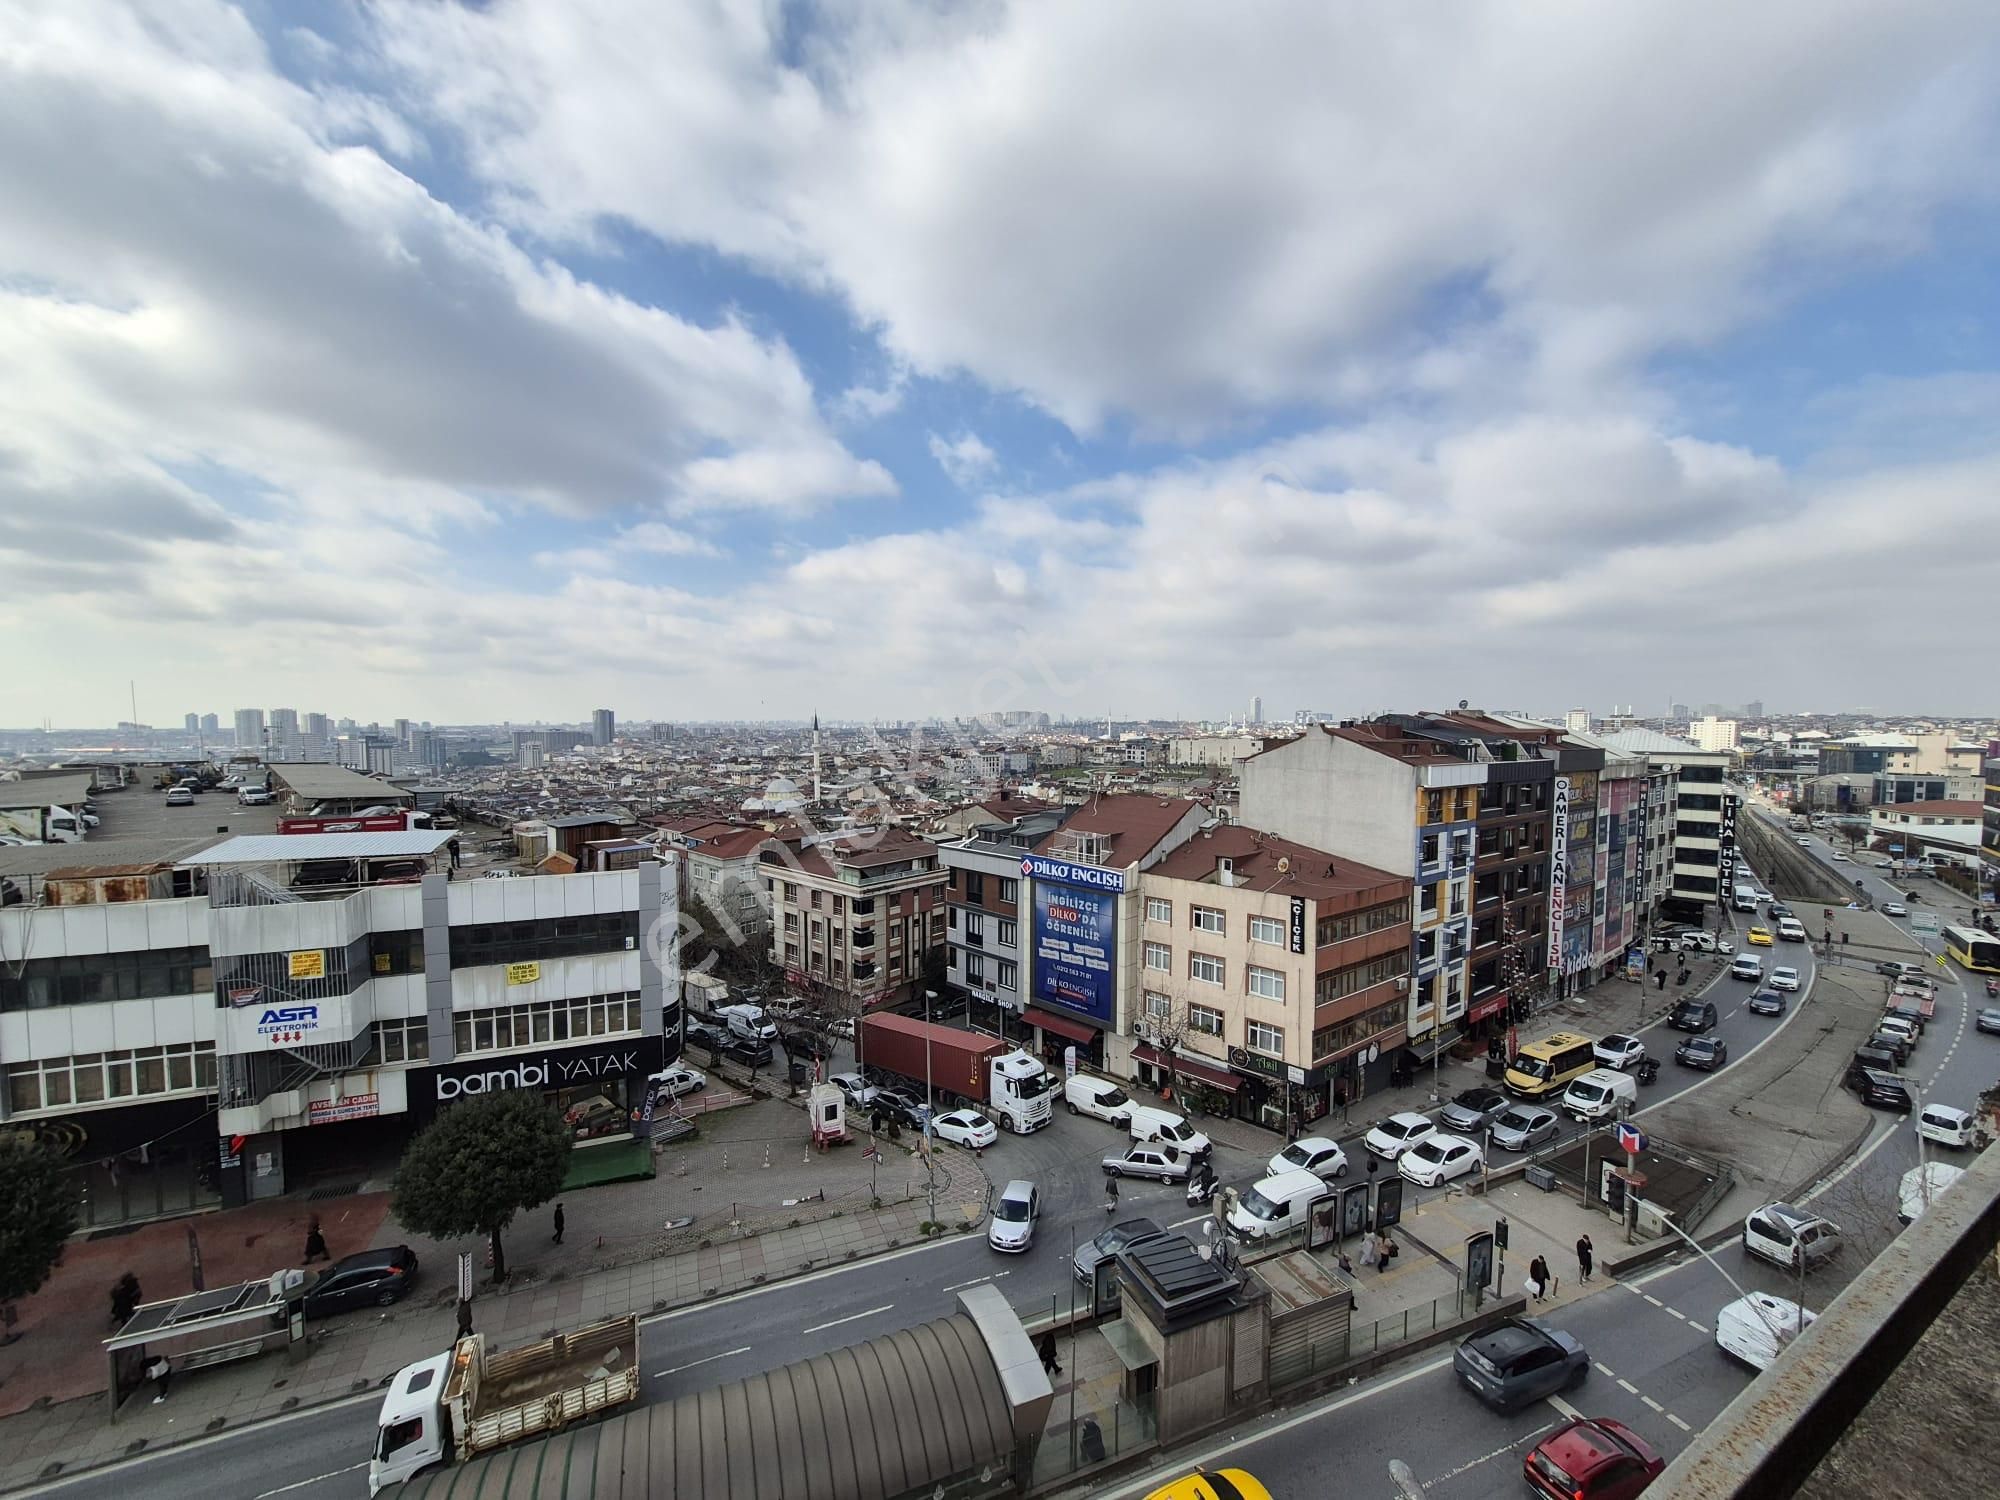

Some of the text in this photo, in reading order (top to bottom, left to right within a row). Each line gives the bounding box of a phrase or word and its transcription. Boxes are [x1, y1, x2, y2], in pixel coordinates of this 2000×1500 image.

[1552, 791, 1567, 885] AMERICAN
[1071, 867, 1123, 889] ENGLISH
[1721, 848, 1733, 896] HOTEL
[1047, 892, 1099, 912] İNGİLİZCE
[1046, 919, 1100, 942] ÖĞRENİLİR
[1293, 905, 1301, 952] ÇİÇEK
[1550, 886, 1563, 966] ENGLISH
[1567, 950, 1594, 975] kiddo
[1069, 982, 1095, 998] ENGLISH
[259, 1005, 319, 1024] ASR
[257, 1021, 319, 1034] ELEKTRONİK
[437, 1051, 638, 1100] bambi YATAK
